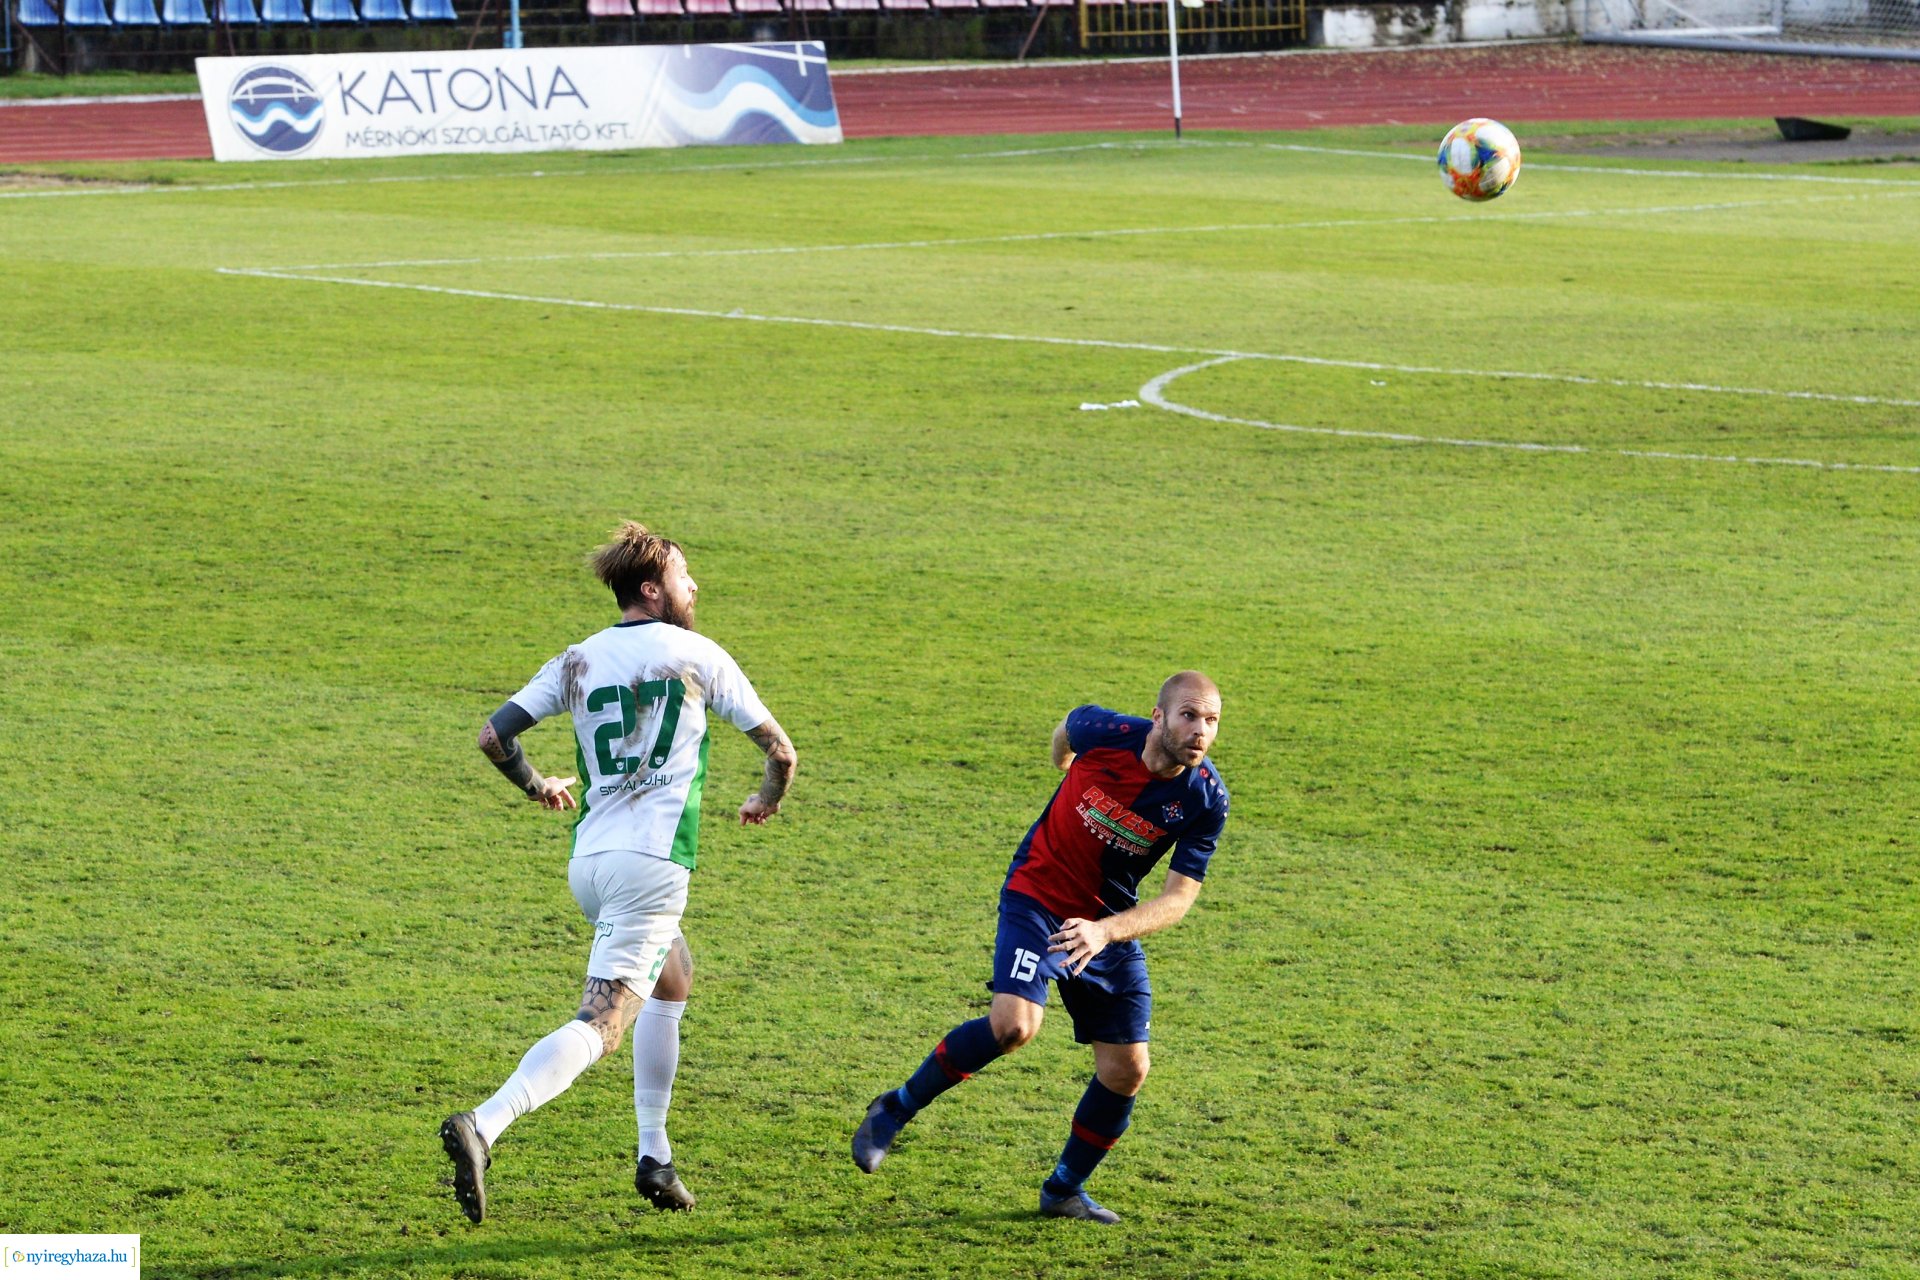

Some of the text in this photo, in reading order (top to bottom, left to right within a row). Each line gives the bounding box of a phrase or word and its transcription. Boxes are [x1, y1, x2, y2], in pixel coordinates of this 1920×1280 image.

[338, 65, 589, 115] KATONA
[345, 120, 634, 148] MÉRNÖKI SZOLGÁLTATÓ KFT.
[586, 677, 686, 776] 27
[1010, 947, 1041, 983] 15
